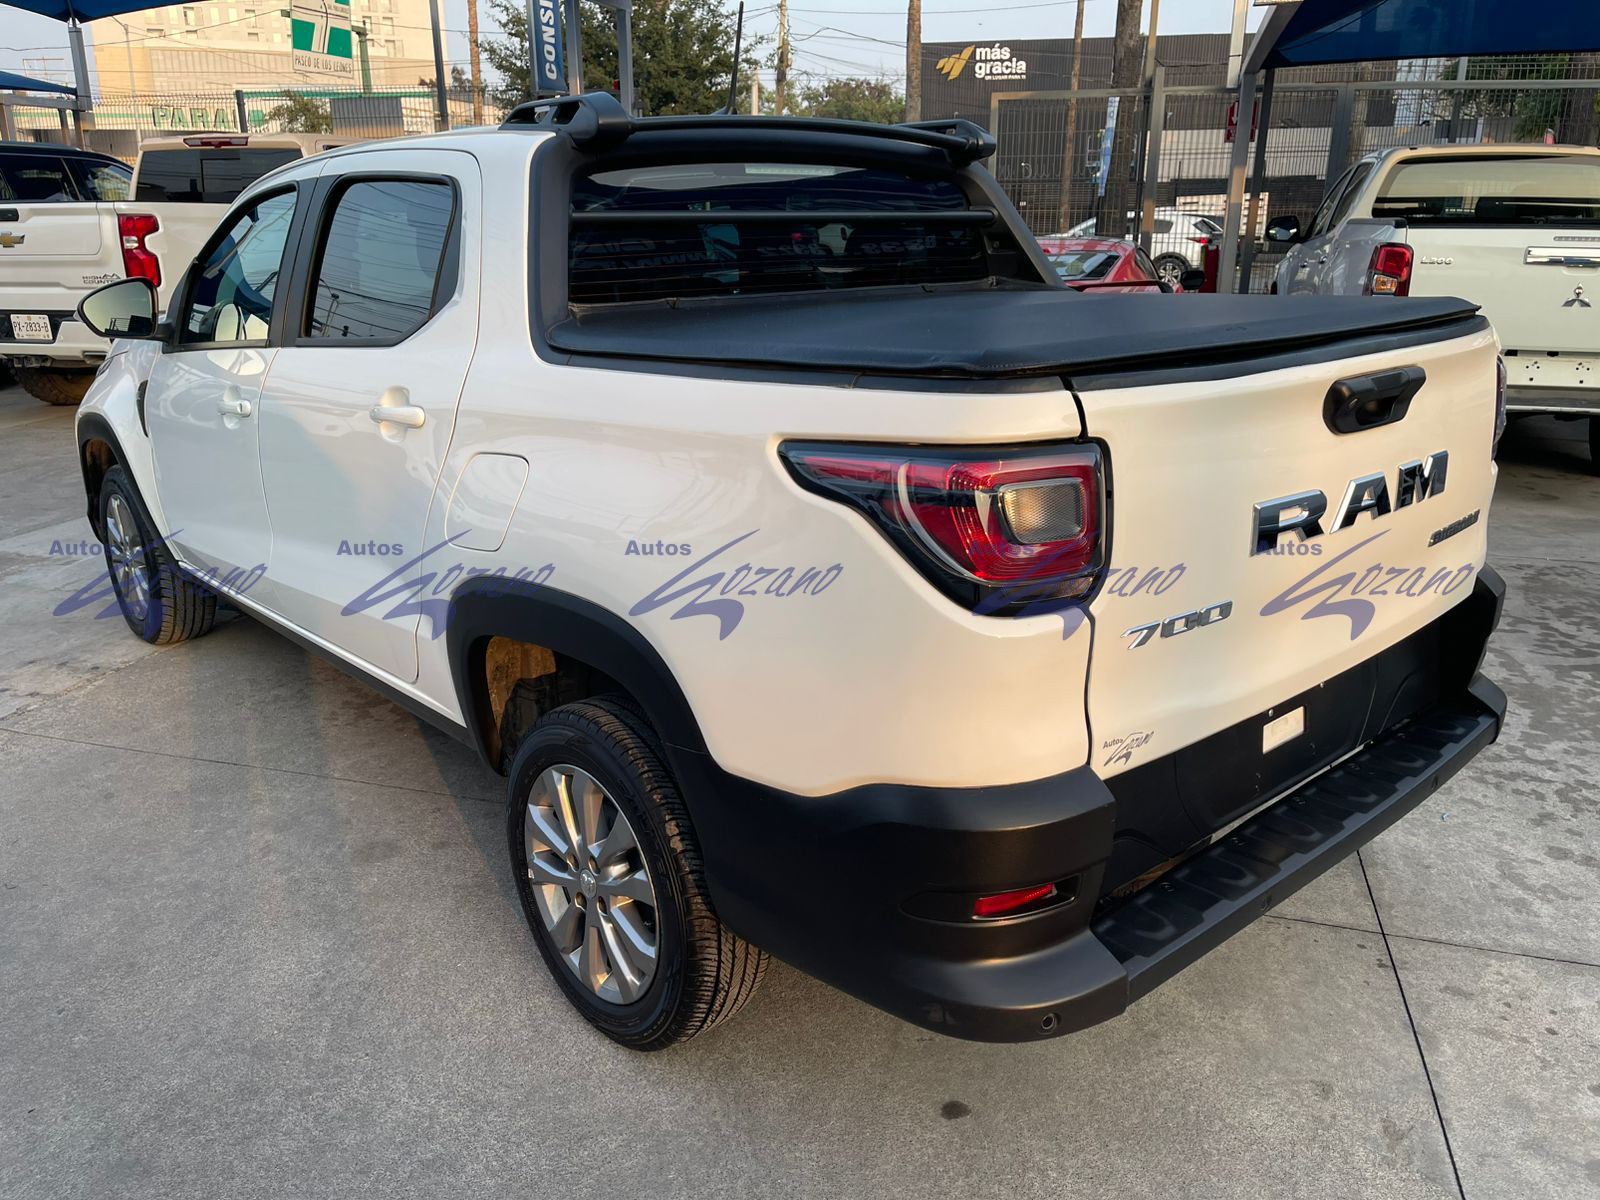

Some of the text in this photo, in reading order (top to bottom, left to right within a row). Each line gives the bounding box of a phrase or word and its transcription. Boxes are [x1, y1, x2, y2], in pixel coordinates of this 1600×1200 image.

[974, 57, 1026, 78] gracia
[975, 43, 1011, 60] más
[1249, 450, 1449, 558] RAM
[1120, 599, 1233, 650] 700
